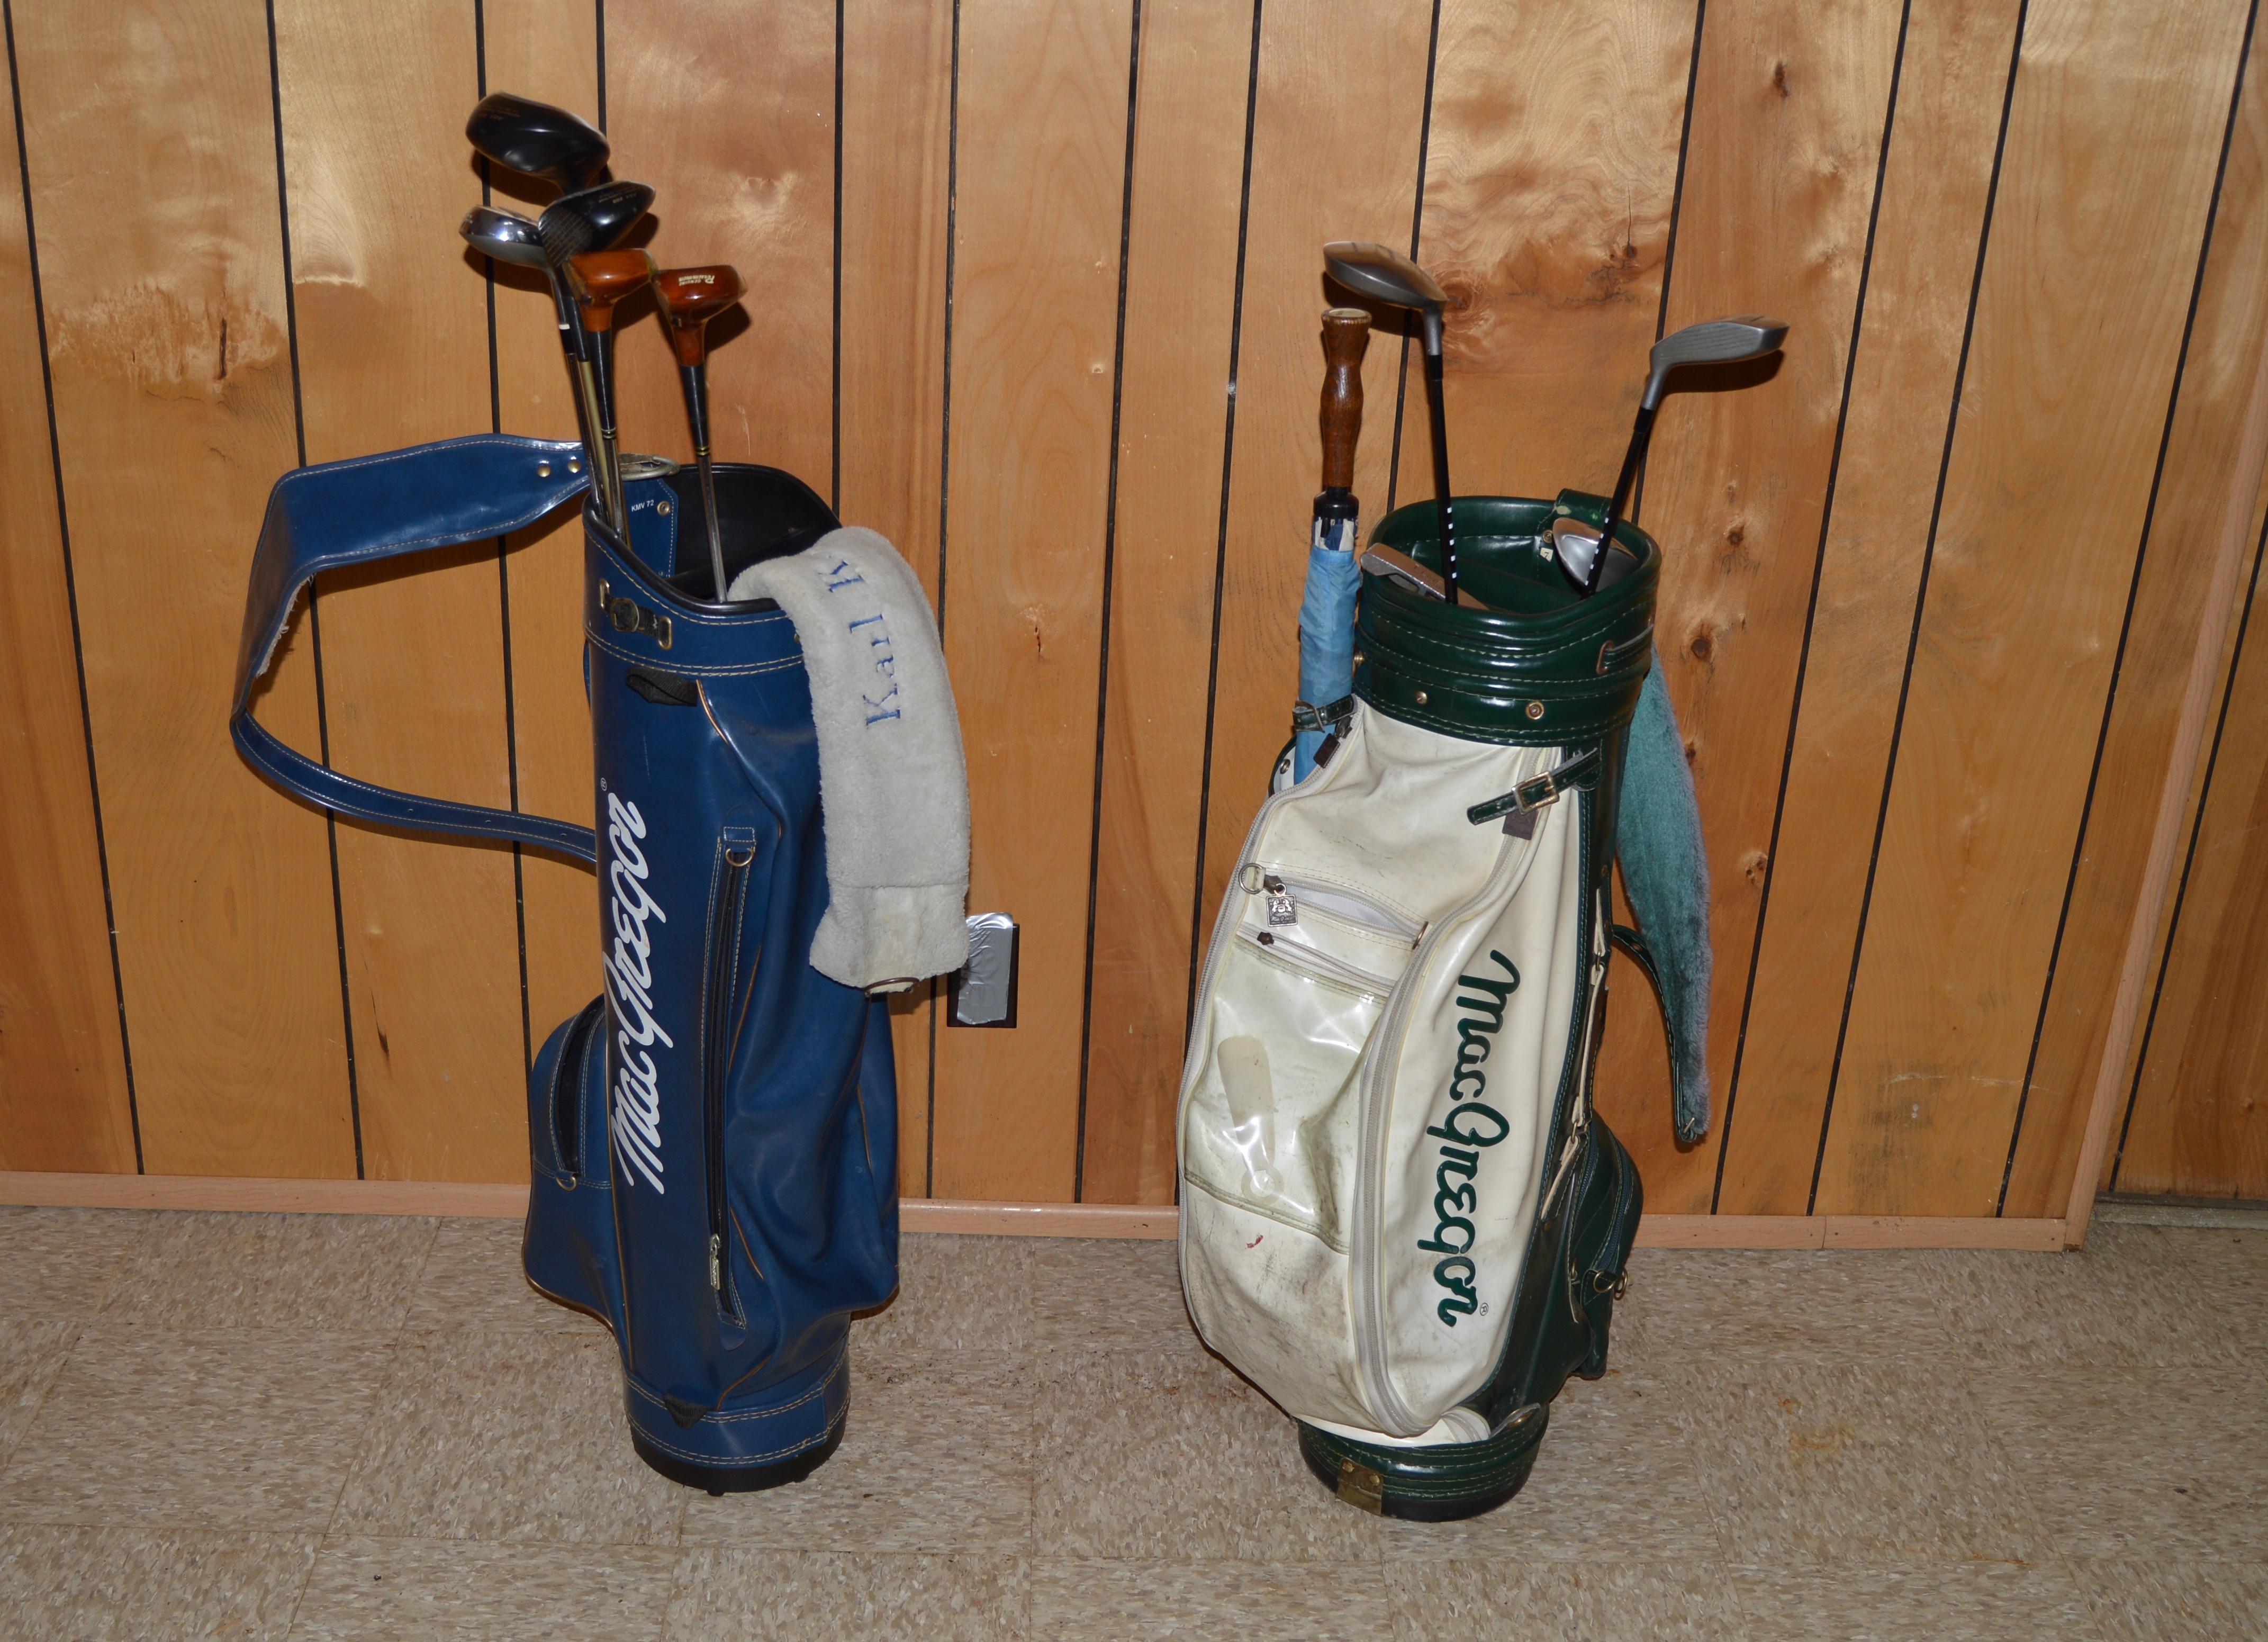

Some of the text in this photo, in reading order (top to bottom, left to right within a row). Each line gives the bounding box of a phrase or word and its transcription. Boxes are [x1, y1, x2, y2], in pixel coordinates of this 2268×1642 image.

[631, 499, 654, 512] KMV 72
[850, 614, 901, 728] Karl
